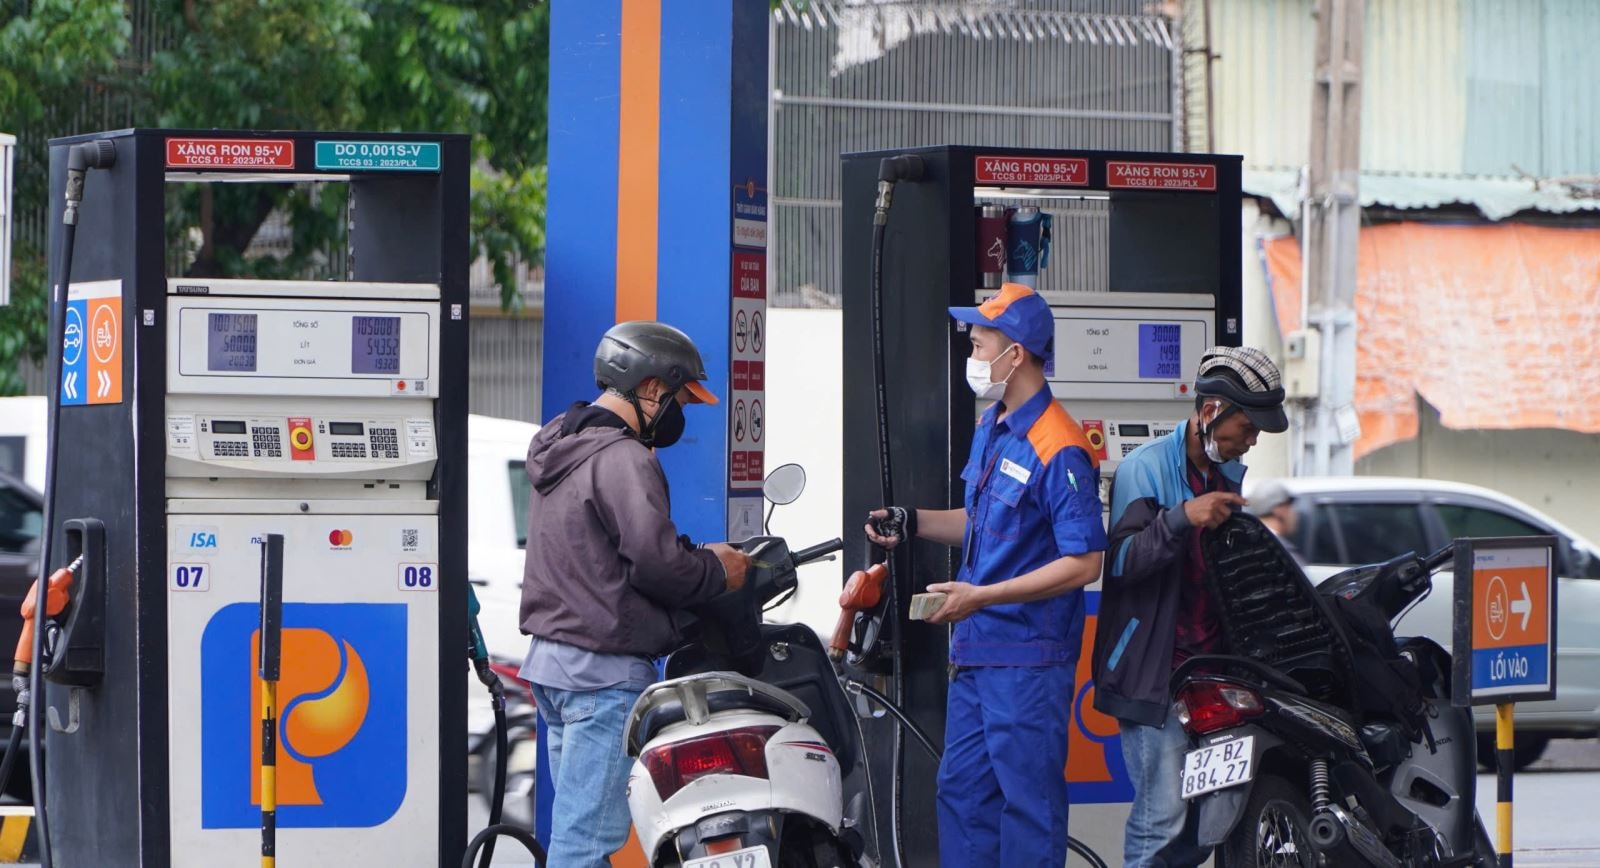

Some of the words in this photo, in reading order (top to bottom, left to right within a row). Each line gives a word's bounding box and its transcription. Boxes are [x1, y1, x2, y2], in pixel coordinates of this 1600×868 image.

[177, 142, 217, 155] XĂNG
[221, 144, 251, 156] RON
[254, 145, 283, 157] 95-V
[335, 144, 357, 156] DO
[360, 144, 421, 158] 0,001S-V
[185, 156, 211, 164] TCCS
[213, 156, 224, 164] 01
[233, 156, 276, 165] 2023/PLX
[338, 158, 362, 166] TCCS
[380, 159, 418, 167] 2023/PLX
[985, 159, 1020, 173] XĂNG
[1023, 162, 1050, 173] RON
[1053, 163, 1078, 174] 95-V
[992, 172, 1015, 181] TCCS
[1017, 173, 1026, 181] 01
[1034, 173, 1072, 182] 2023/PLX
[1116, 164, 1150, 177] XĂNG
[1153, 167, 1179, 178] RON
[1182, 168, 1208, 179] 95-V
[1125, 178, 1147, 186] TCCS
[1148, 178, 1157, 186] 01
[1164, 179, 1199, 187] 2023/PLX
[176, 566, 203, 588] 07
[404, 566, 432, 588] 08
[1490, 651, 1506, 681] LỐI
[1508, 652, 1528, 679] VÀO
[1185, 760, 1249, 794] 884.27
